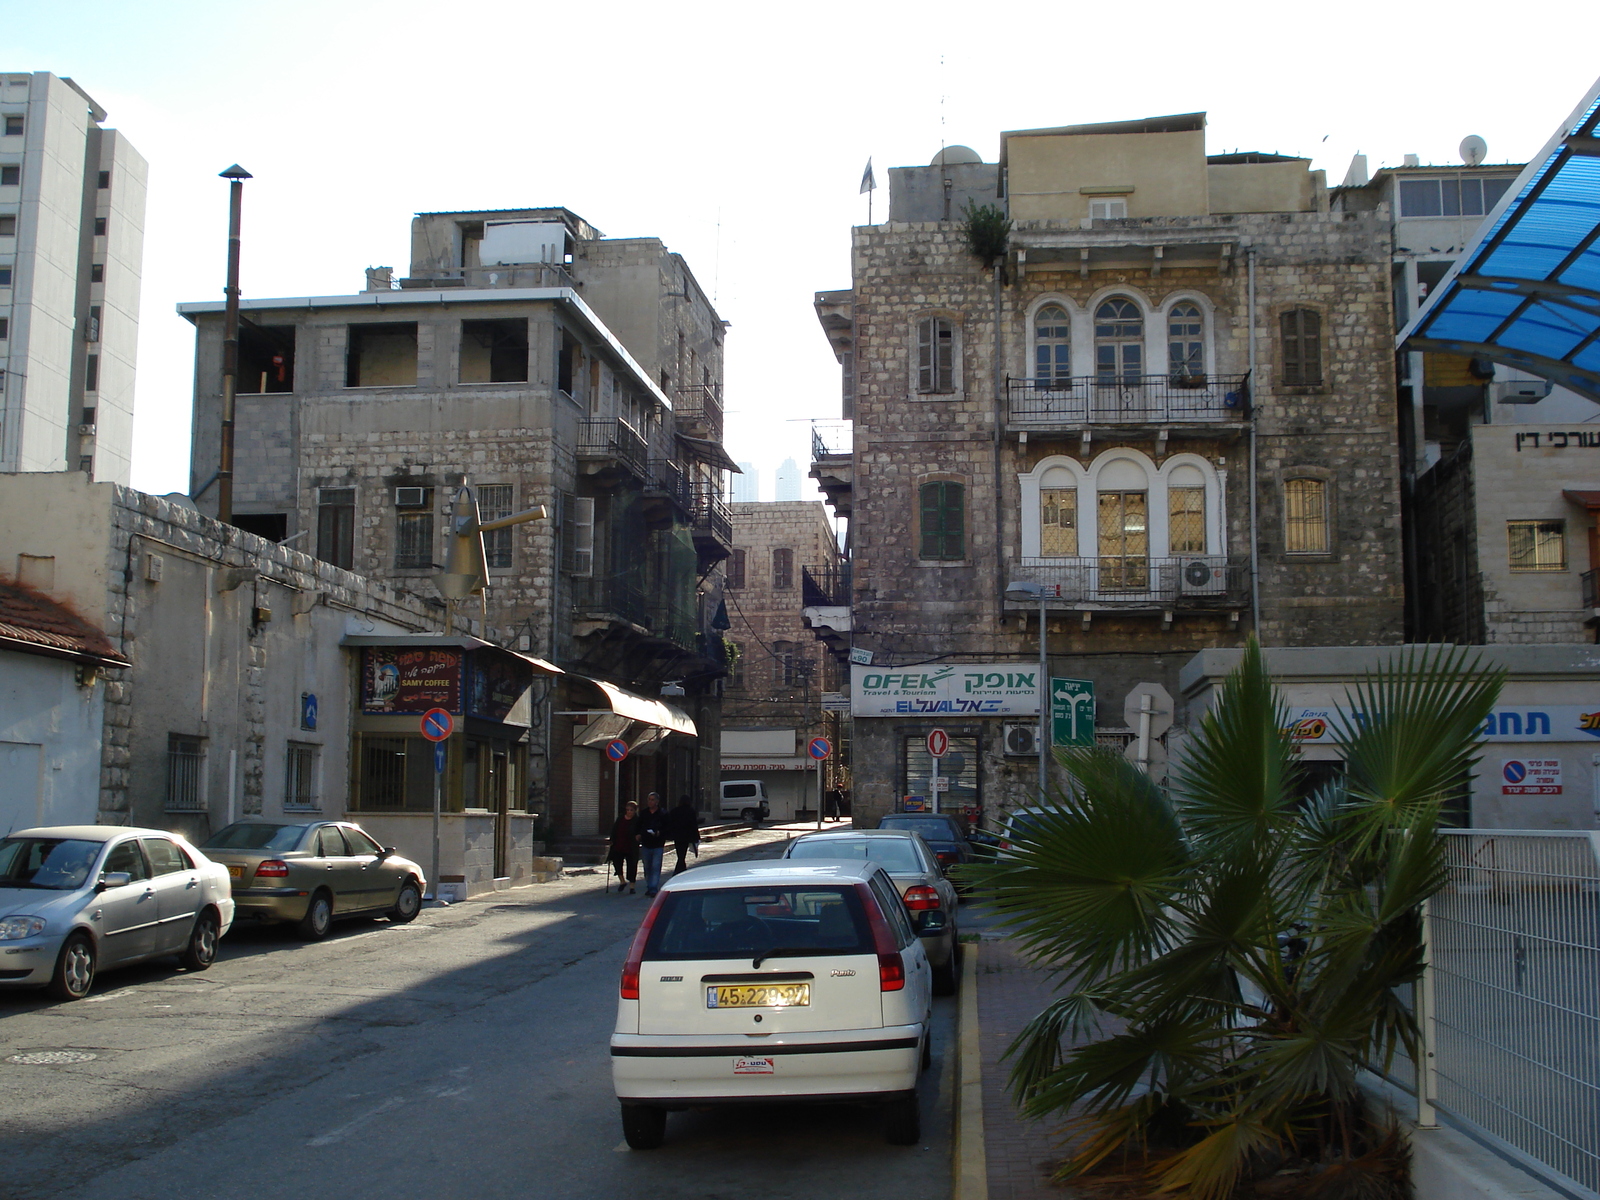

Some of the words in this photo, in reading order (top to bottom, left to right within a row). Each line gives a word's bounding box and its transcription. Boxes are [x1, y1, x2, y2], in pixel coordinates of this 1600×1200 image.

[1516, 432, 1540, 452] דין
[430, 650, 457, 668] קפה
[401, 679, 423, 687] SAMY
[424, 679, 450, 687] COFFEE
[863, 673, 938, 689] OFEK
[964, 673, 1036, 693] אופק
[830, 968, 857, 978] Punto
